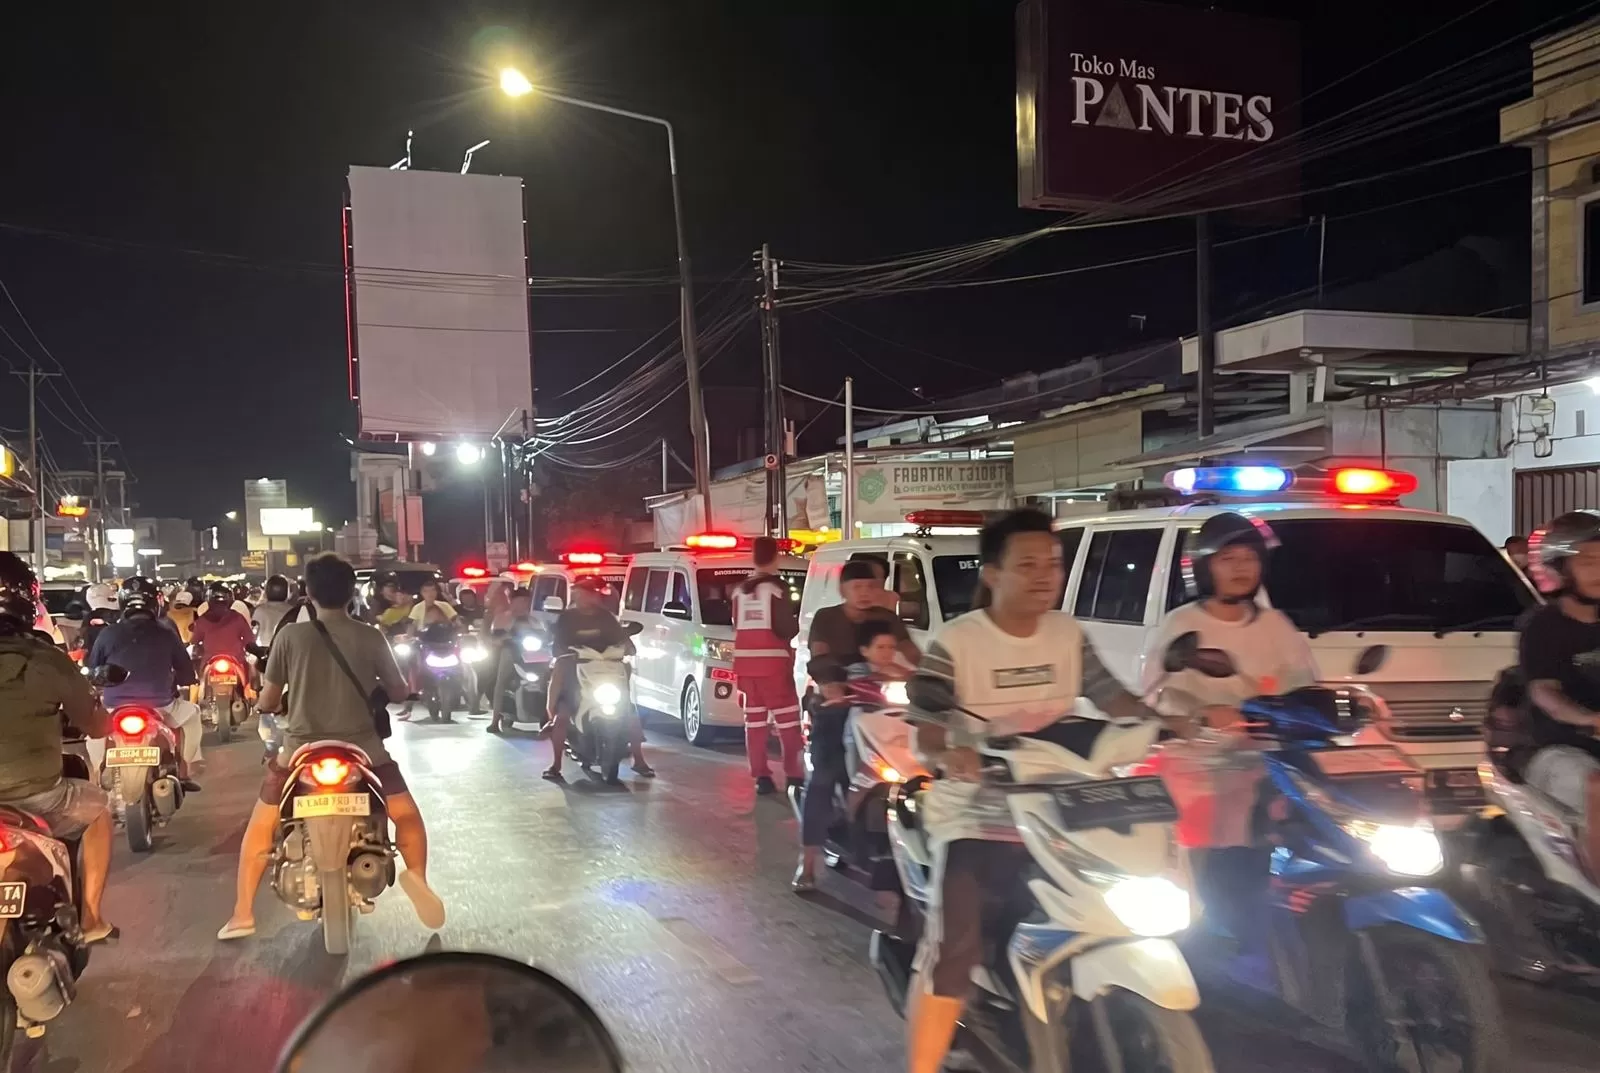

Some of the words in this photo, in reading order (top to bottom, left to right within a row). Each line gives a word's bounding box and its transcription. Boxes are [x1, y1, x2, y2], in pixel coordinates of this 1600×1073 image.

[1070, 53, 1115, 76] Toko
[1119, 58, 1156, 79] Mas
[1070, 77, 1275, 142] PANTES
[3, 885, 21, 901] TA
